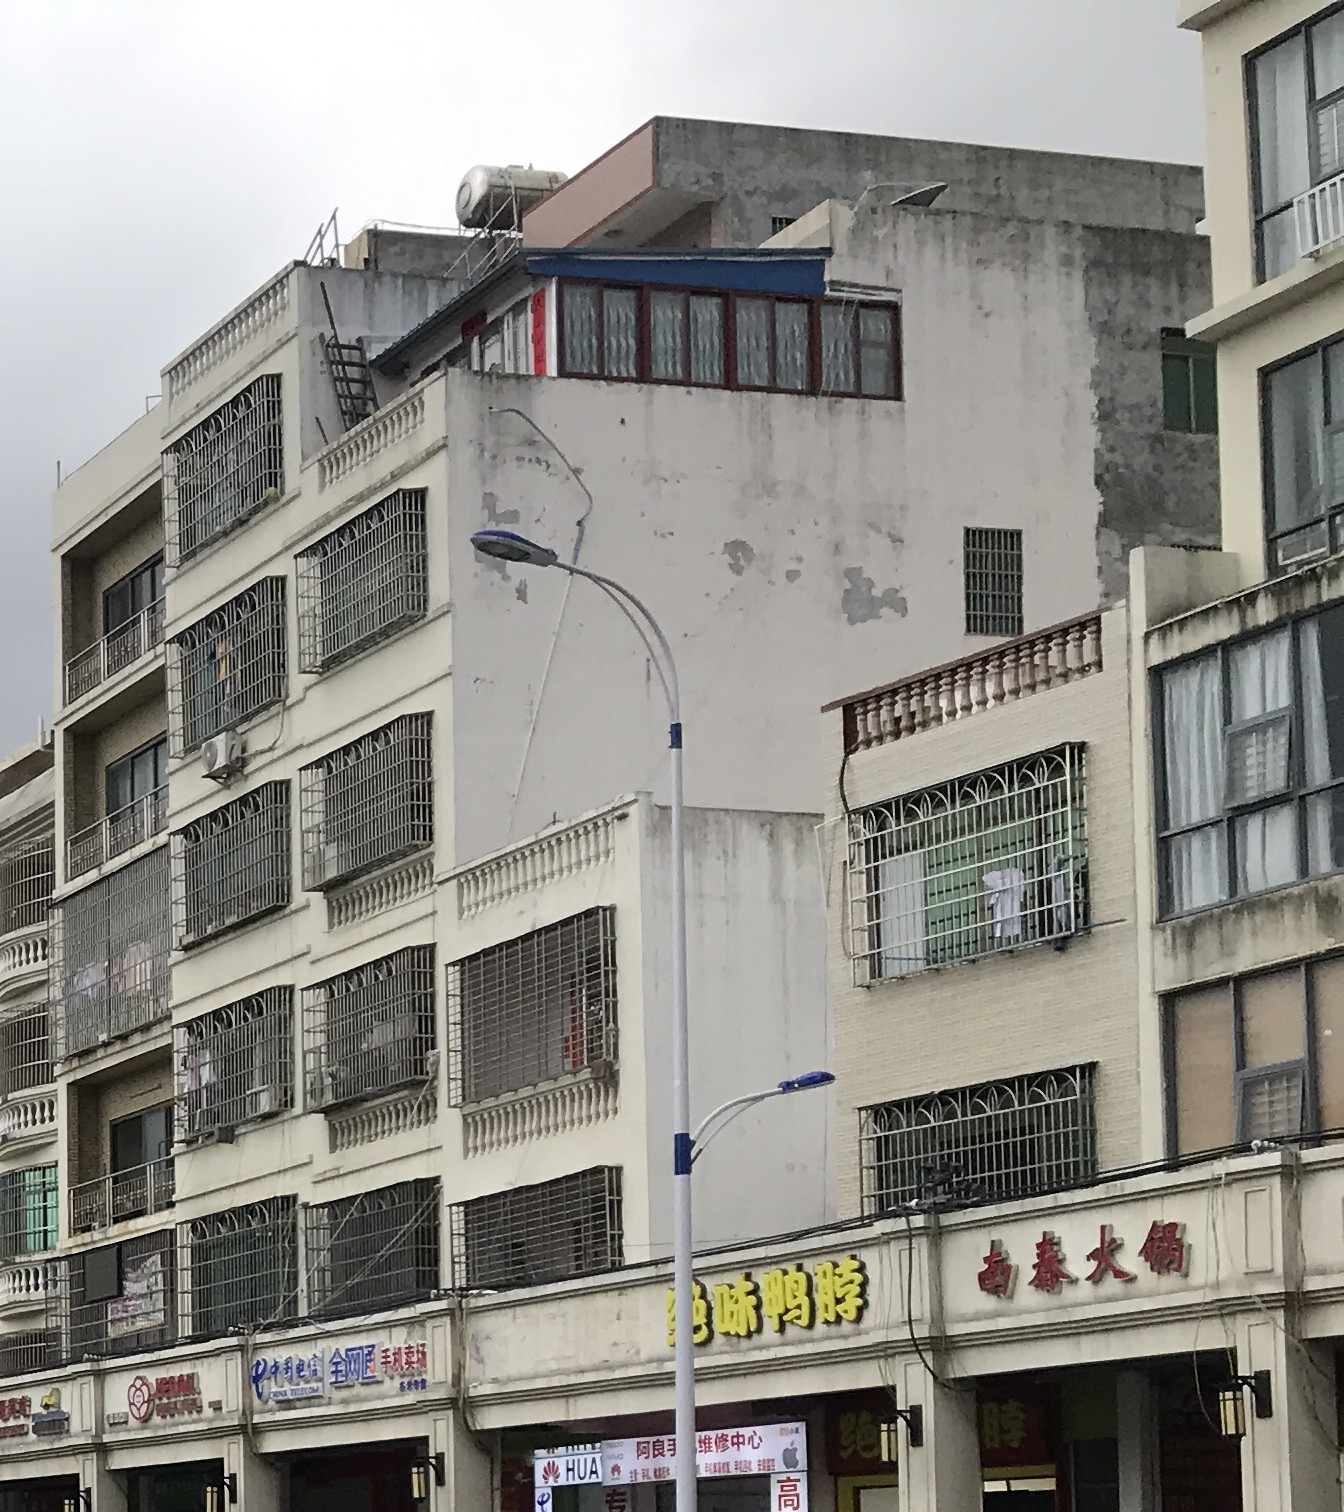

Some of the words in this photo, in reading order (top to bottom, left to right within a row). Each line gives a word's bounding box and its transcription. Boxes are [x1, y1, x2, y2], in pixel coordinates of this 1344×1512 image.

[976, 1219, 1188, 1297] 南春火锅
[666, 1253, 870, 1348] 绝味鸭脖
[269, 1353, 320, 1386] 中国电信
[329, 1344, 377, 1387] 全网通
[381, 1342, 428, 1374] 手机卖场
[636, 1430, 763, 1460] 阿良手维修中心
